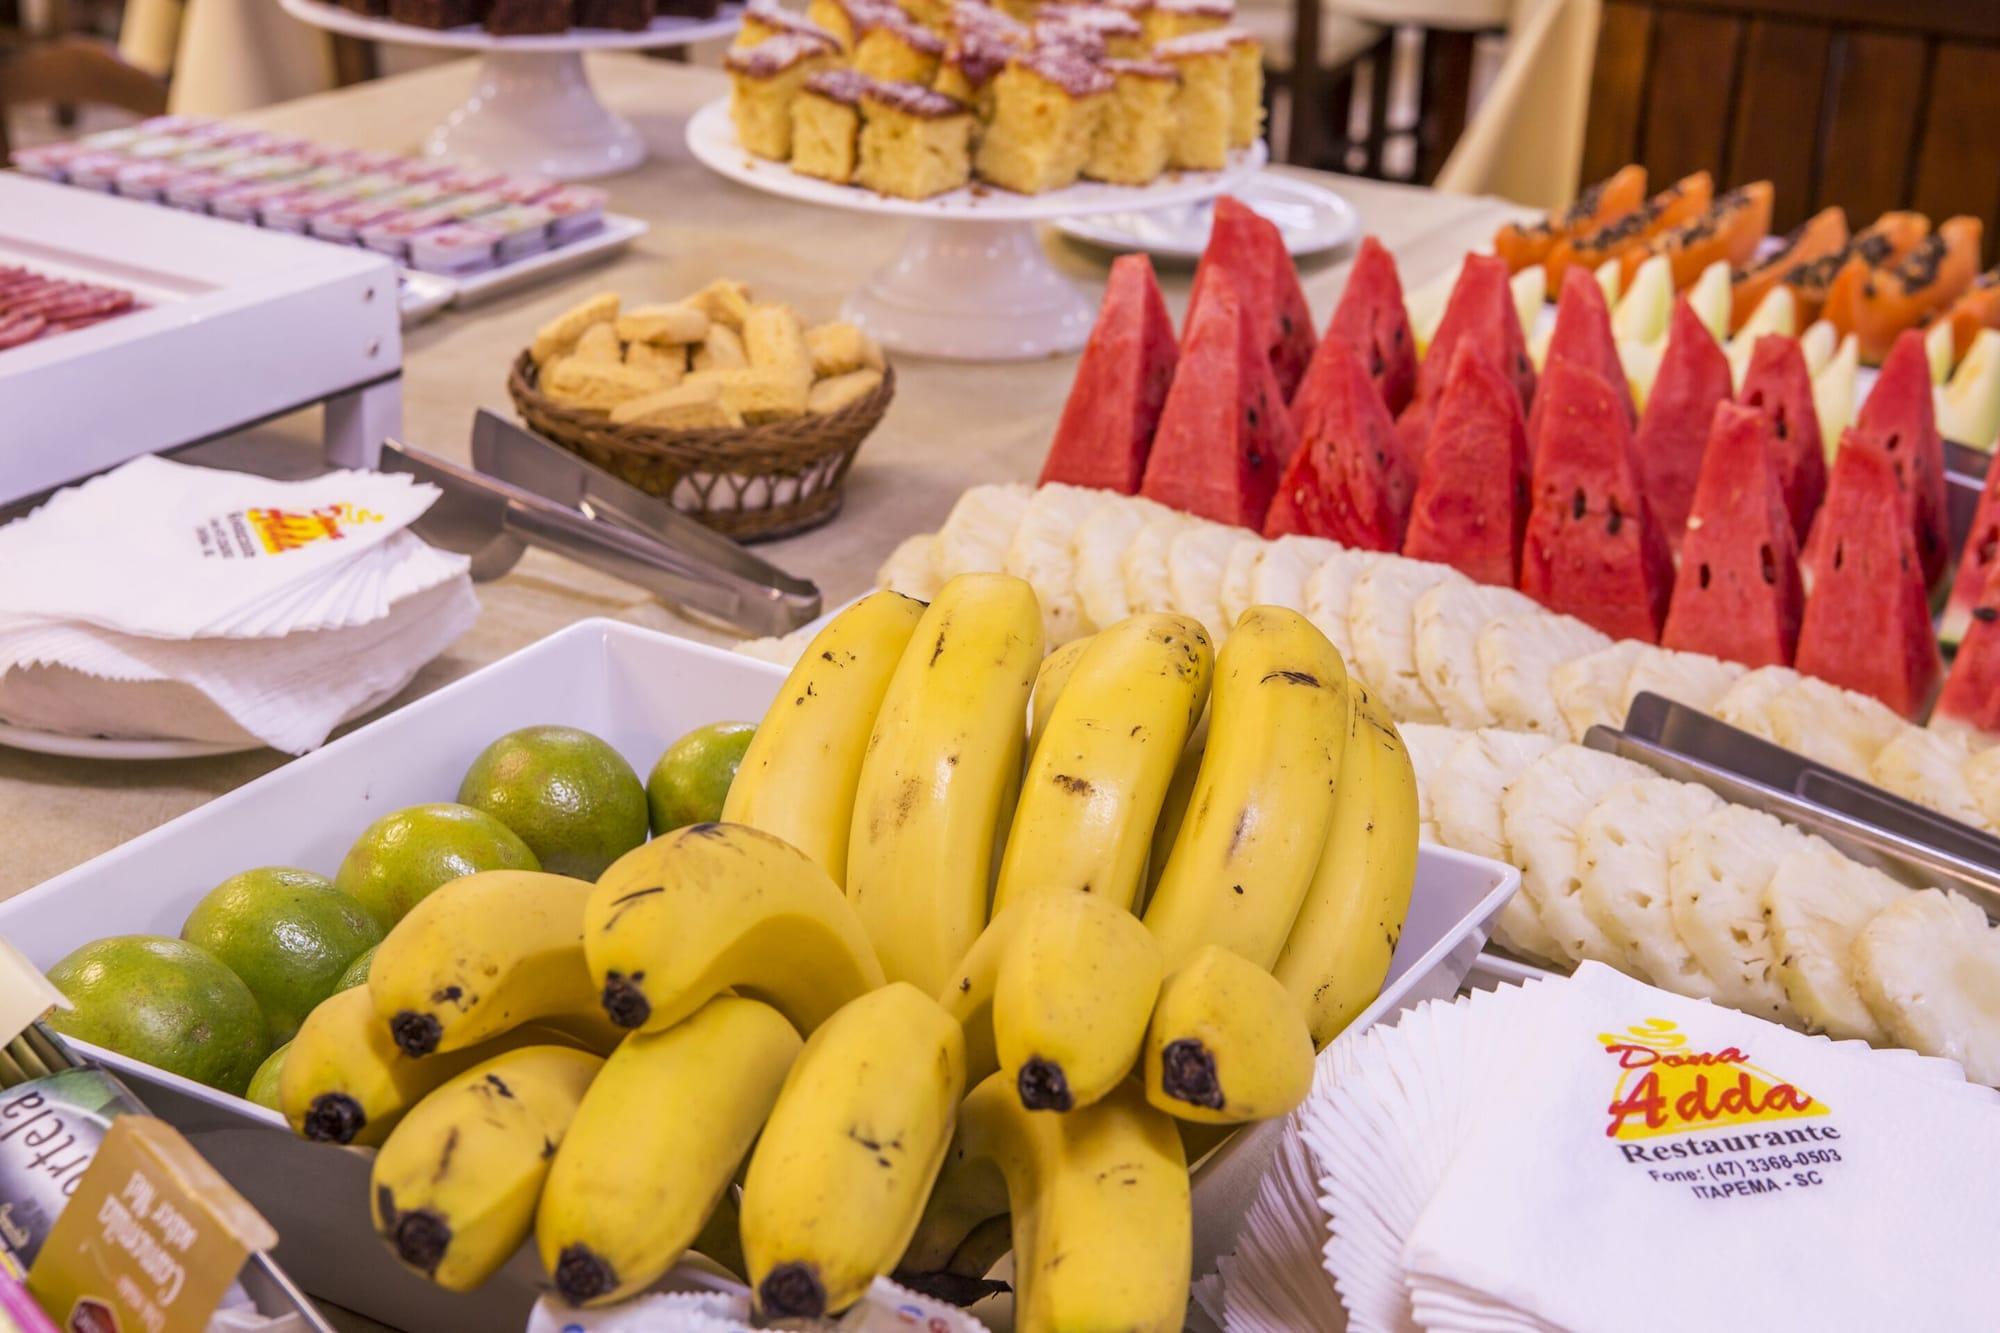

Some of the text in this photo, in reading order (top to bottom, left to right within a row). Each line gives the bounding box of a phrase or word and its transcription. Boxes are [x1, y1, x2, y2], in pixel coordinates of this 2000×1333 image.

[1605, 1044, 1749, 1069] Dona
[1606, 1071, 1813, 1138] Adda
[1617, 1123, 1841, 1164] Restaurante
[1648, 1148, 1842, 1183] Fone: (47) 3368-0503
[1691, 1177, 1782, 1201] ITAPEMA
[1796, 1170, 1824, 1188] SC
